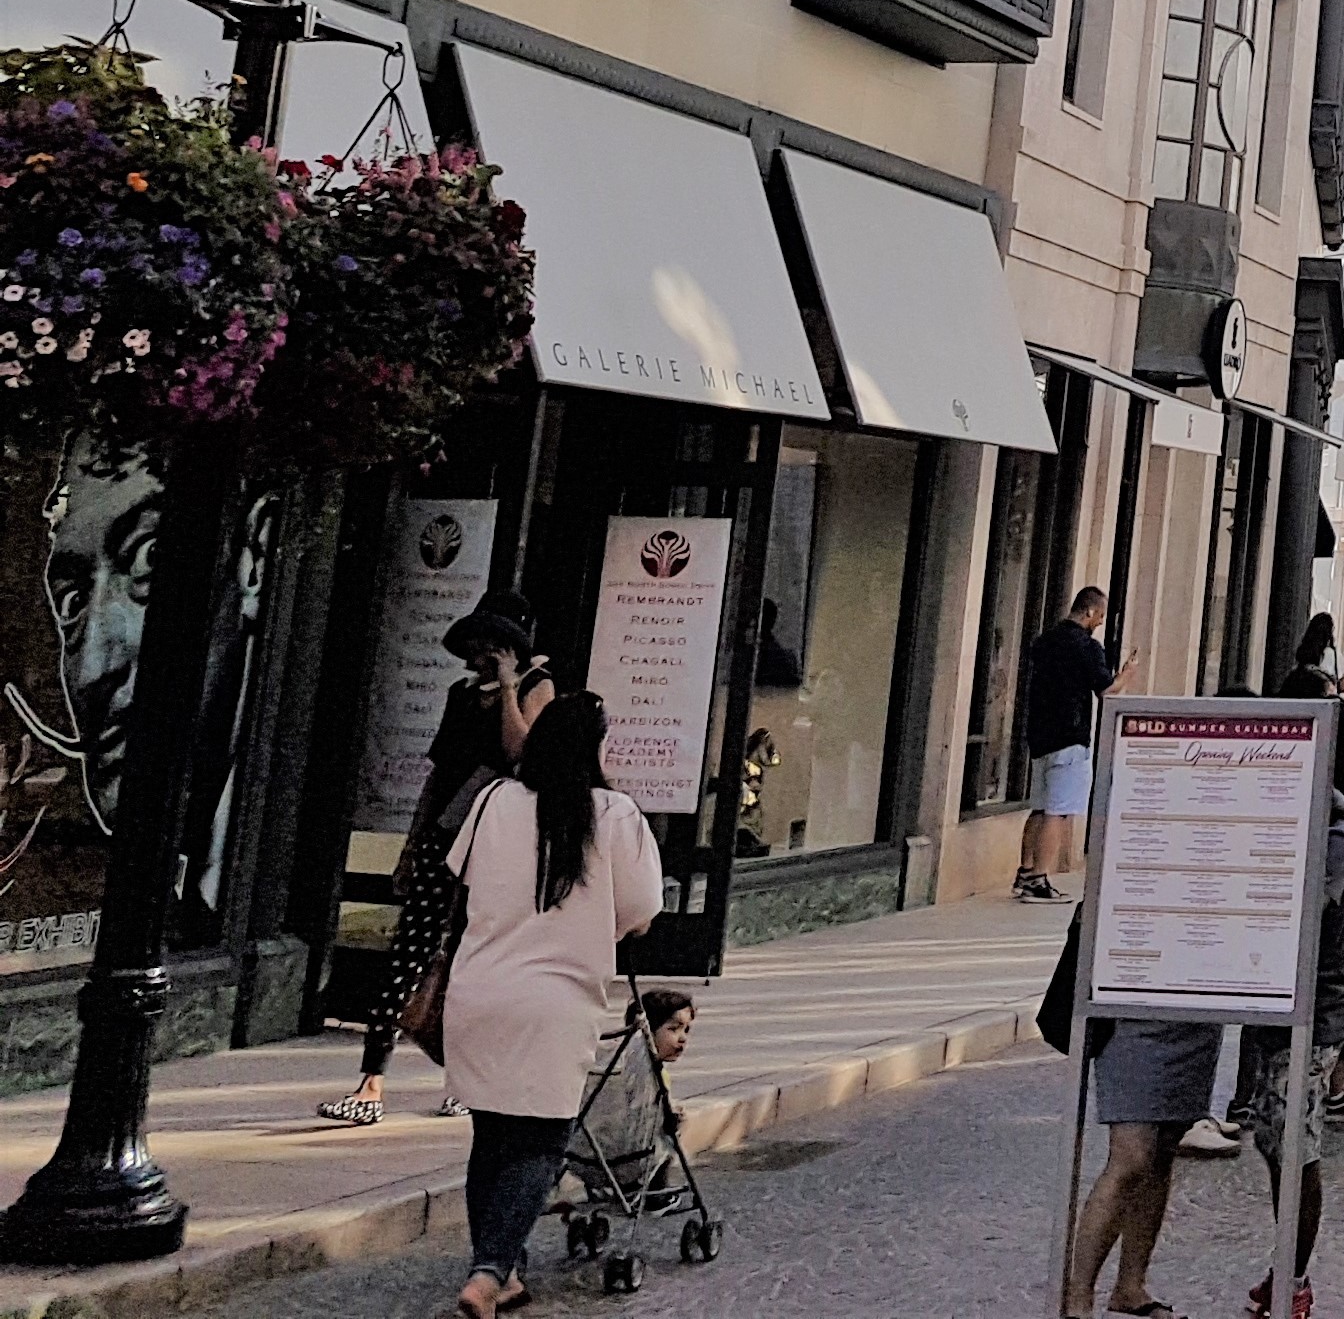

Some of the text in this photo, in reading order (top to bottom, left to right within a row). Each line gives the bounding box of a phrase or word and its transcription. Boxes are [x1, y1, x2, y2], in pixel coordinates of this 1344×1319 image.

[552, 343, 814, 405] GALERIE MICHAEL
[617, 594, 704, 606] REMBRANDT
[631, 615, 685, 626] RENOIR
[623, 635, 687, 646] PICASSO
[619, 655, 683, 666] CHAGALL
[608, 715, 682, 726] BARBIZON
[1126, 719, 1309, 735] BOLD SUMMER CALENDAR
[607, 747, 674, 756] ACADEMY
[1184, 740, 1297, 768] Opening Weekend
